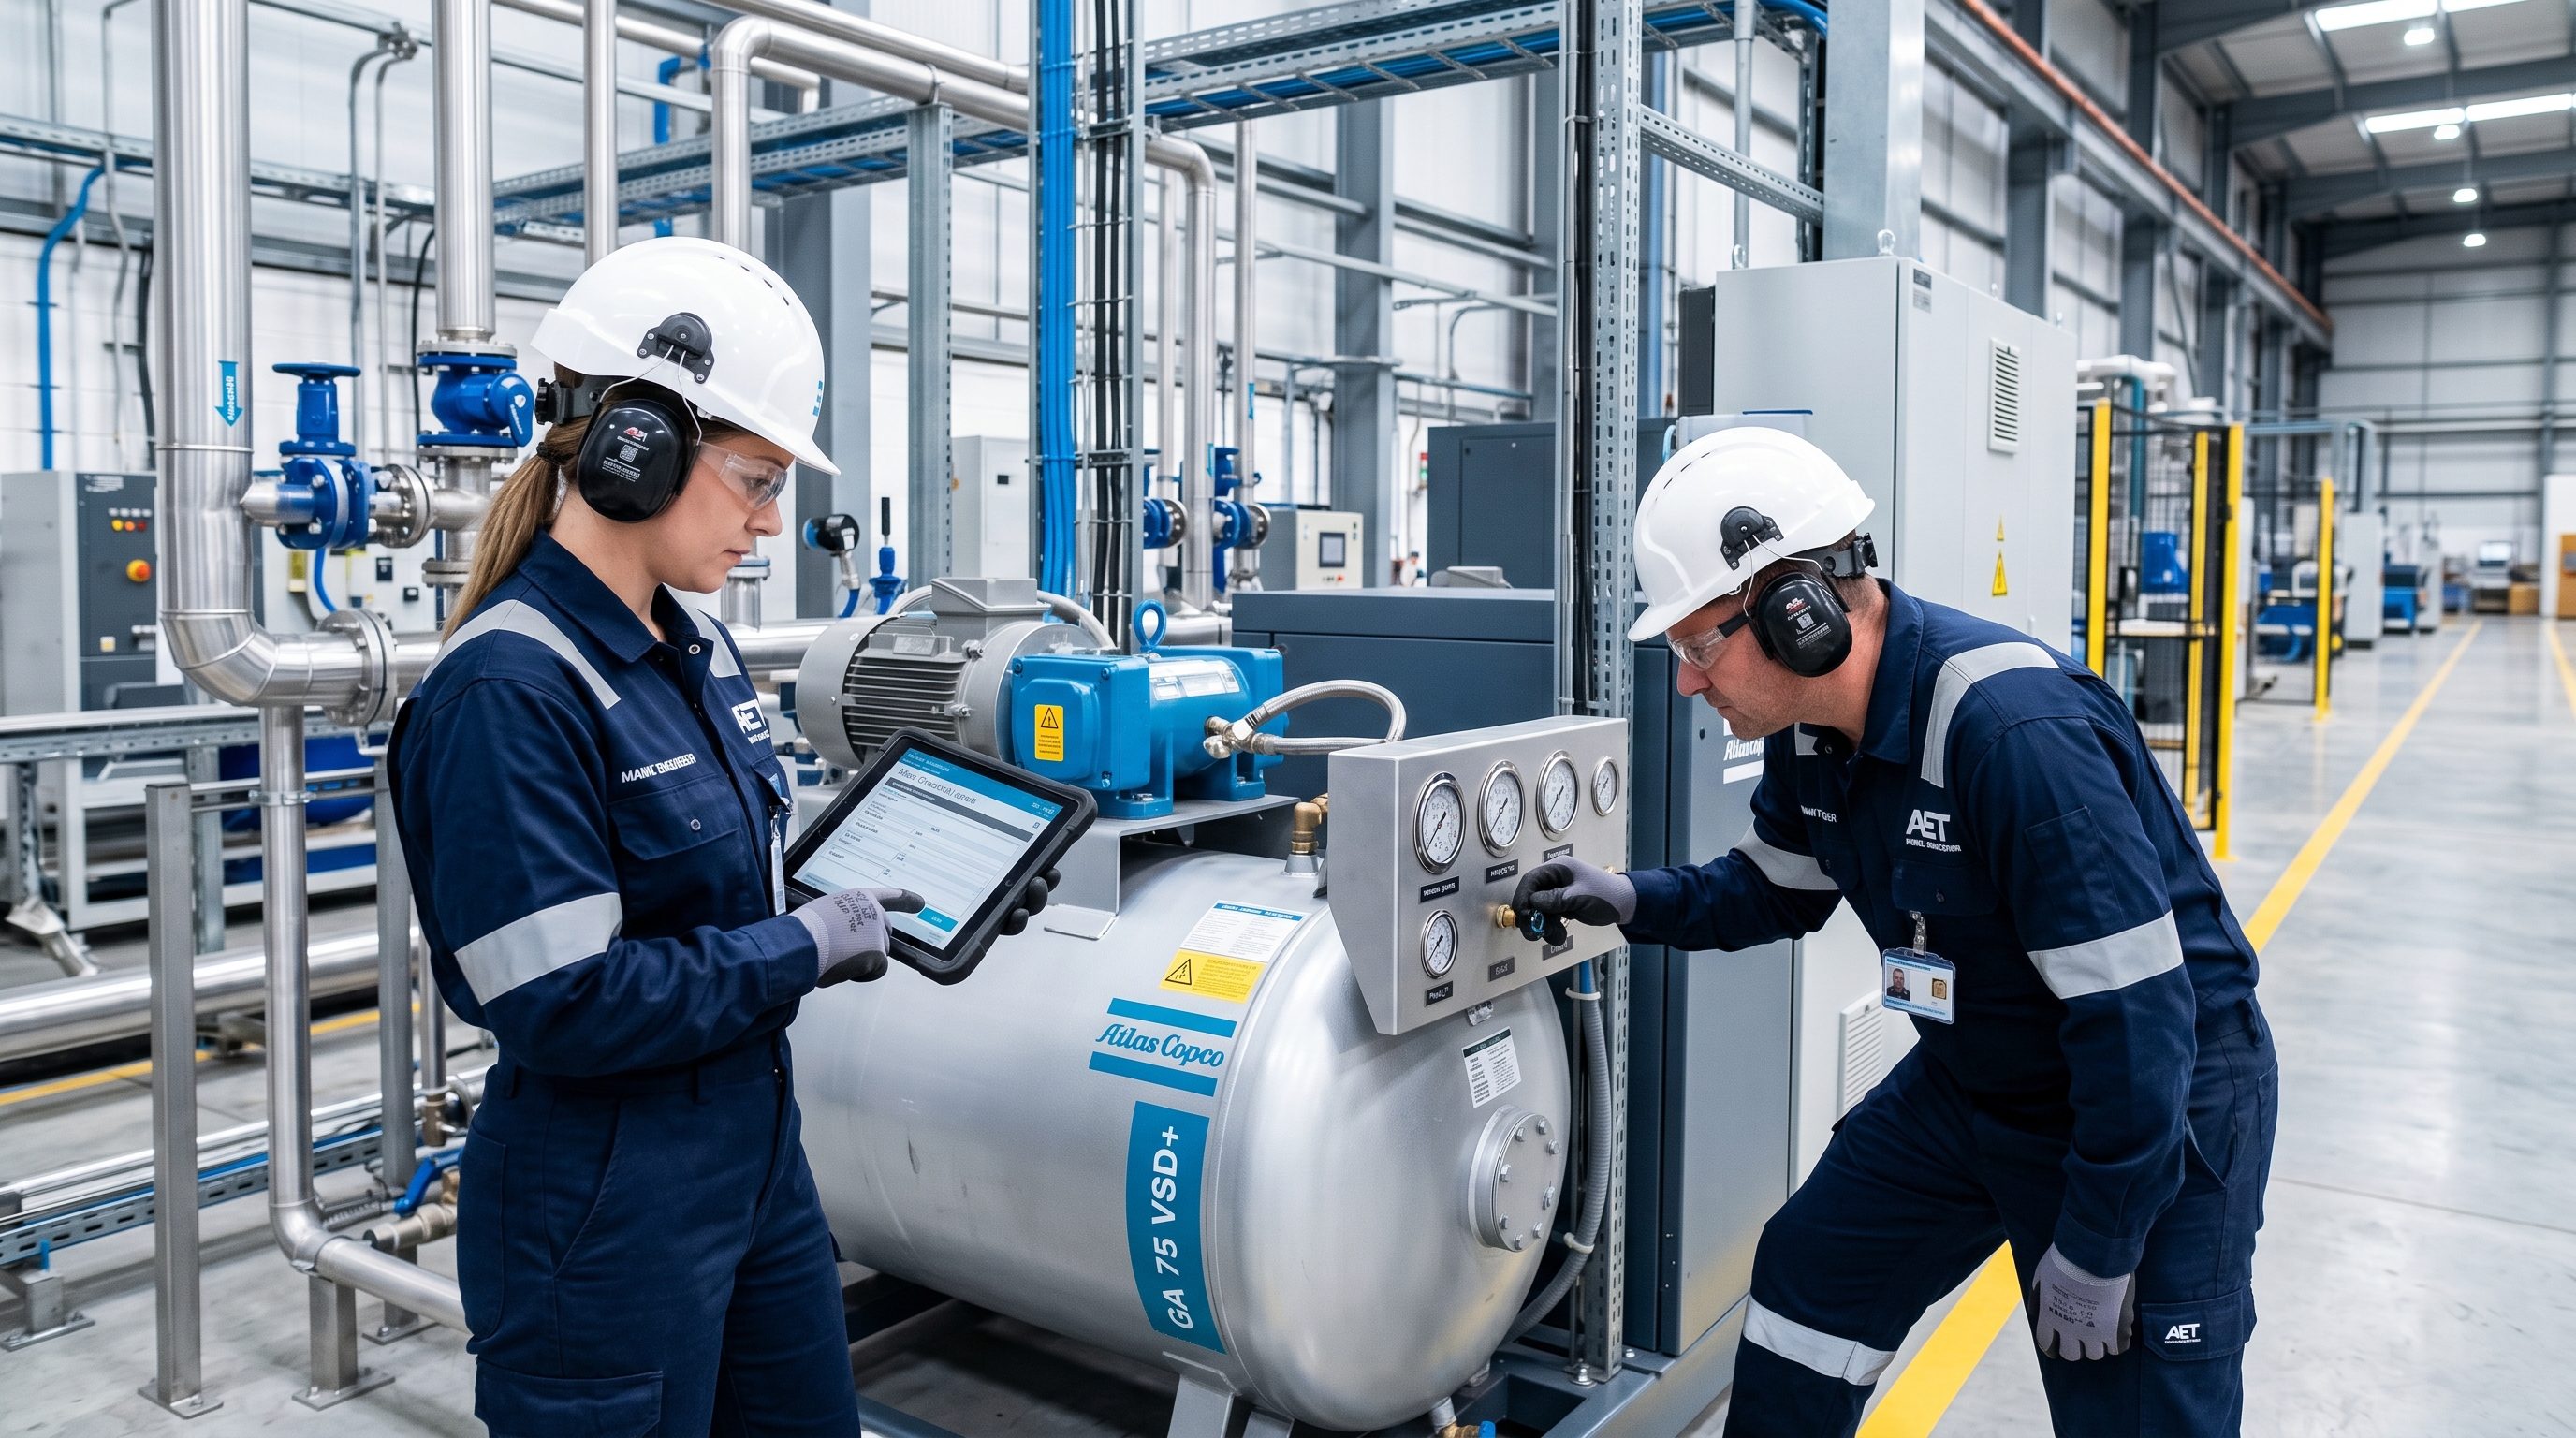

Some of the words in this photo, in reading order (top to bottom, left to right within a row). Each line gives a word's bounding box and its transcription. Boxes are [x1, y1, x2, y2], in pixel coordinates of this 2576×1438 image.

[1906, 809, 1951, 842] AET
[1095, 1023, 1160, 1054] Atlas
[1161, 1034, 1225, 1067] Copco
[1151, 1125, 1178, 1225] VSD+
[1153, 1236, 1180, 1276] 75
[1163, 1289, 1193, 1329] GA
[2165, 1323, 2200, 1340] AET
